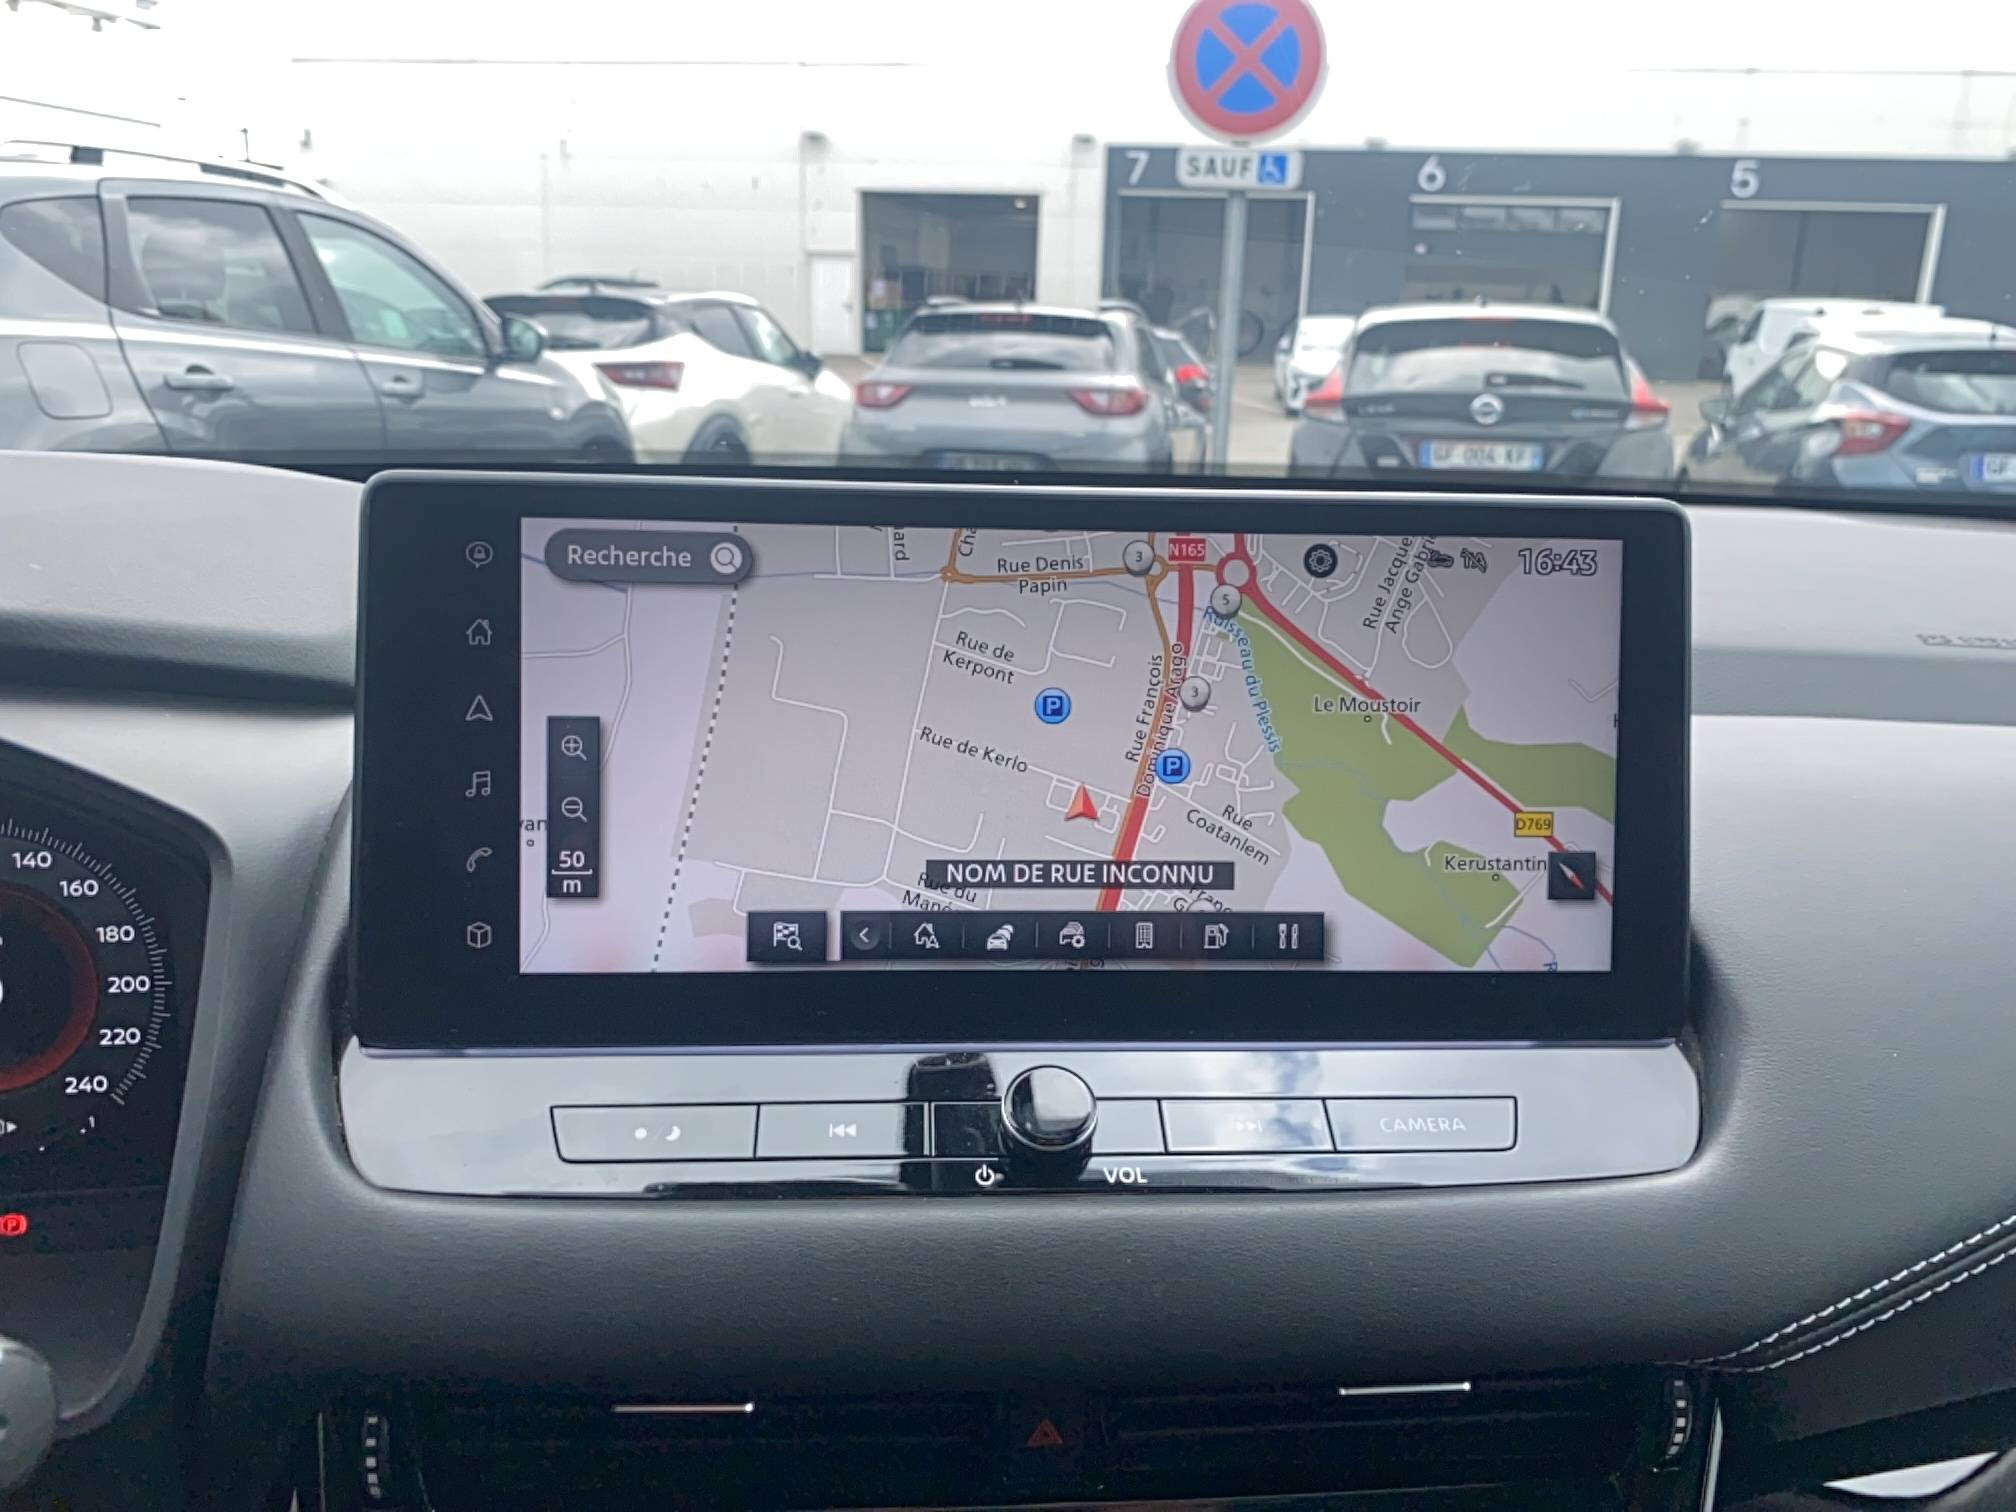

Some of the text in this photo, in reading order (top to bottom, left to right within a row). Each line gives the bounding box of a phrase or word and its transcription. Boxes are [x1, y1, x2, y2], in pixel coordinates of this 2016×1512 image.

[1126, 152, 1149, 185] 7
[1186, 157, 1252, 177] SAUF
[1418, 154, 1446, 192] 6
[1730, 159, 1759, 198] 5
[894, 527, 911, 561] ard
[1169, 543, 1206, 558] N165
[567, 545, 691, 567] Recherche
[998, 555, 1084, 573] Rue Denis
[1135, 551, 1143, 562] 3
[1518, 548, 1597, 577] 16:43
[1018, 578, 1068, 595] Papin
[1362, 535, 1415, 630] Rue Jacque
[1222, 594, 1230, 605] 5
[1385, 587, 1412, 635] Ange
[955, 630, 1015, 662] Rue de
[943, 649, 1015, 685] Kerpont
[1192, 686, 1199, 698] 3
[1125, 655, 1163, 763] Rue François
[1244, 675, 1262, 697] du
[1253, 699, 1281, 752] Plessis
[1314, 697, 1422, 714] Le Moustoir
[1136, 643, 1187, 797] Dominique Arago
[919, 727, 1028, 774] Rue de Kerlo
[1221, 804, 1254, 831] Rue
[1516, 817, 1551, 832] D769
[1186, 809, 1270, 866] Coatanlem
[12, 851, 52, 869] 140
[559, 851, 585, 868] 50
[1445, 855, 1546, 872] Kerustantin
[947, 864, 1214, 884] NOM DE RUE INCONNU
[60, 879, 99, 897] 160
[563, 879, 581, 893] m
[96, 925, 135, 943] 180
[108, 976, 151, 993] 200
[100, 1028, 141, 1046] 220
[65, 1076, 108, 1094] 240
[89, 1116, 96, 1128] 1
[1379, 1117, 1467, 1133] CAMERA
[1103, 1167, 1148, 1184] VOL
